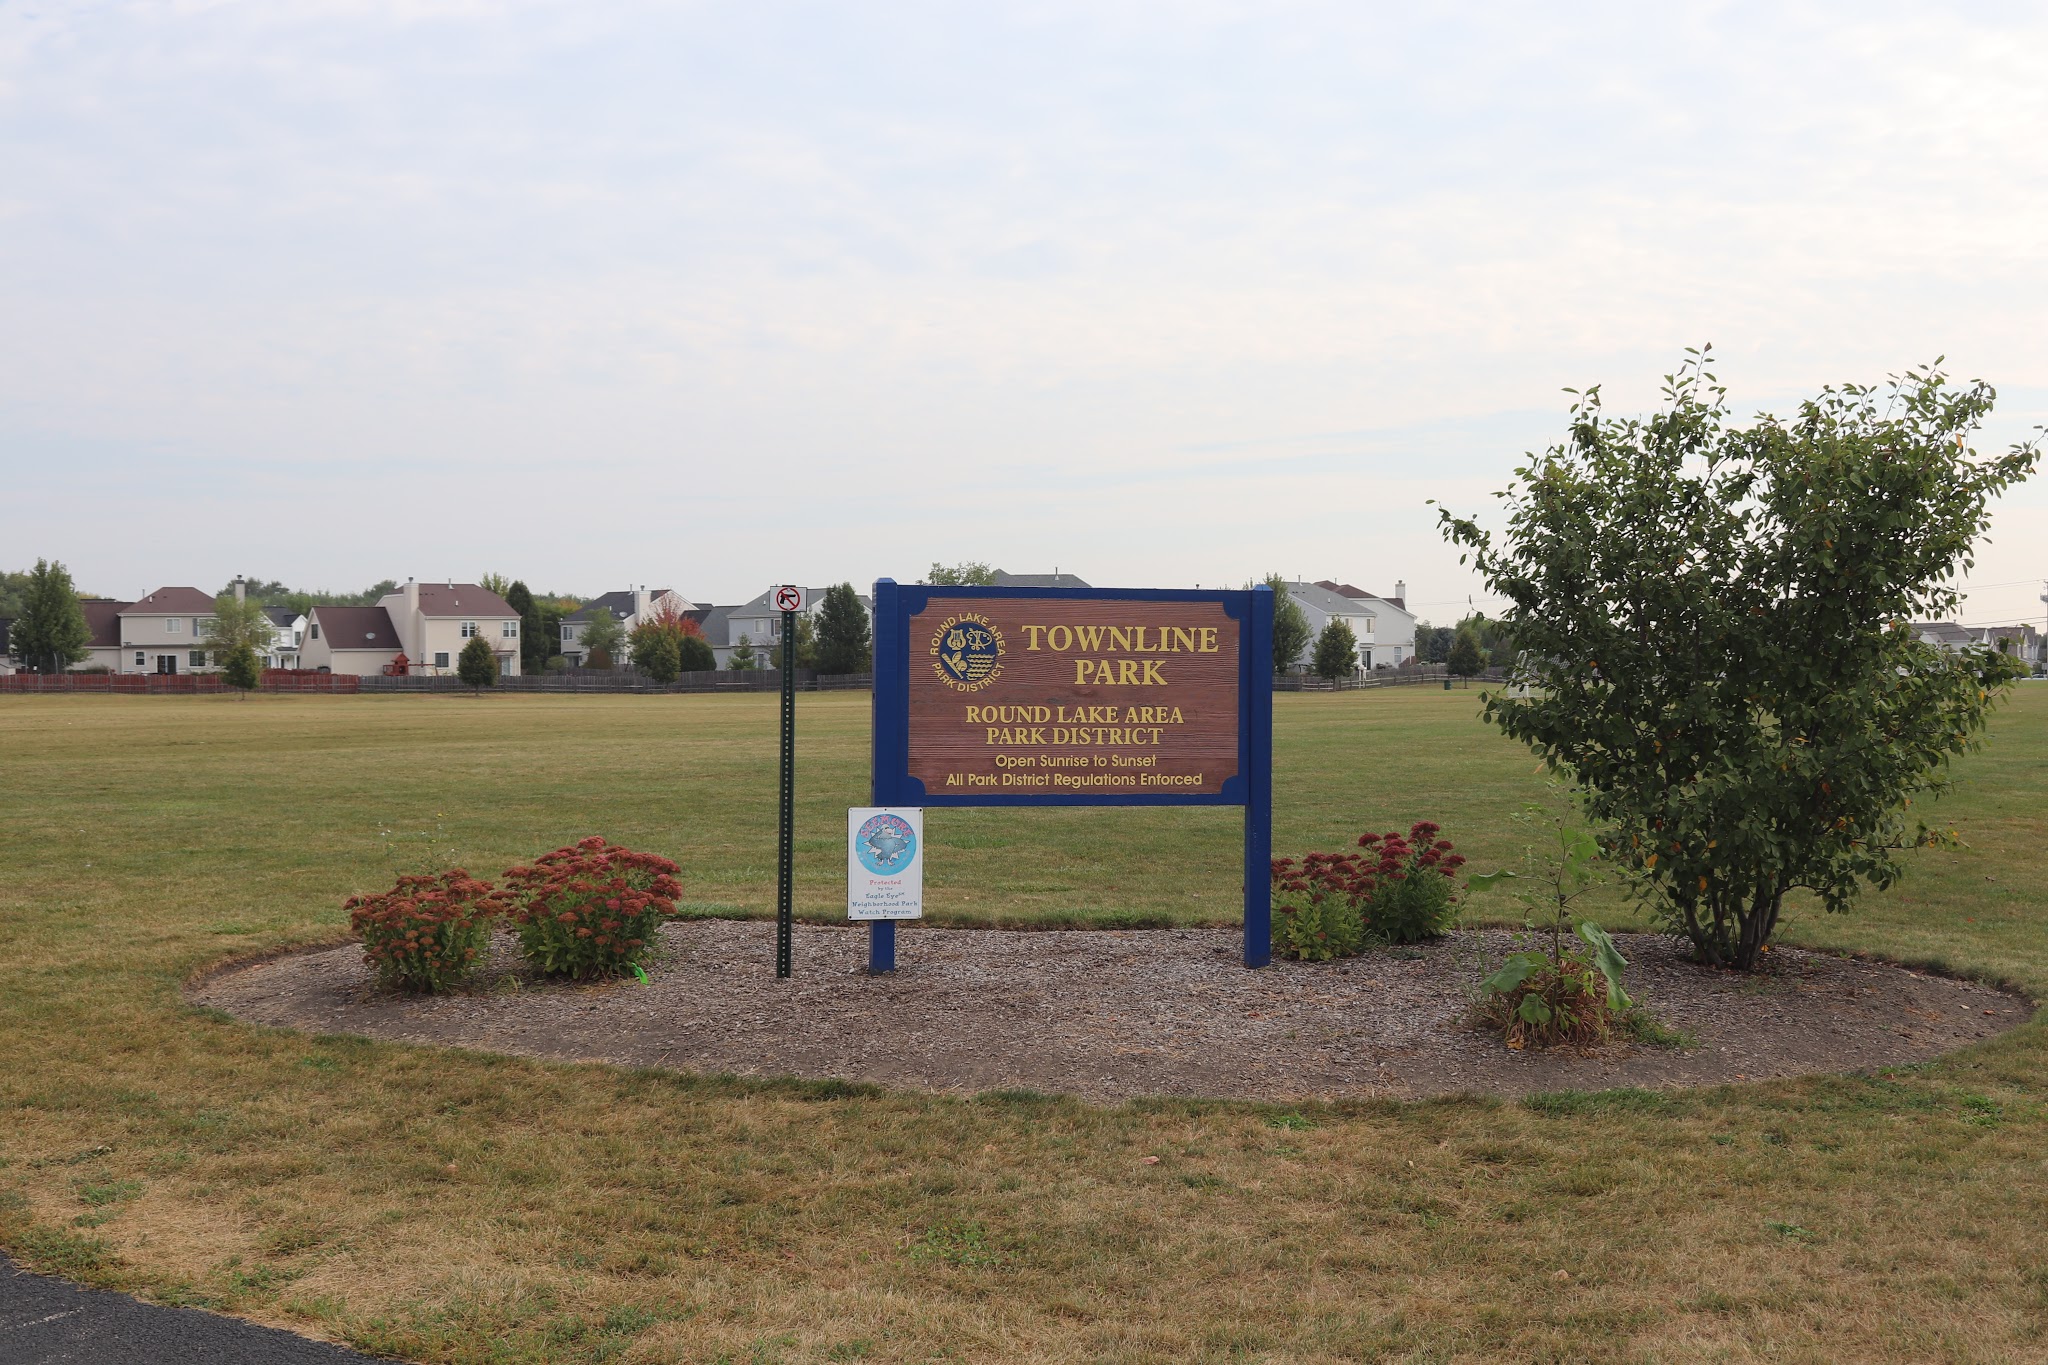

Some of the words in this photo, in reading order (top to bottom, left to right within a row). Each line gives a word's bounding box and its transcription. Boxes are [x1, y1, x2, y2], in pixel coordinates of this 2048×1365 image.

[930, 616, 956, 655] ROUND
[959, 612, 989, 627] LAKE
[988, 625, 1006, 656] AREA
[1021, 625, 1219, 652] TOWNLINE
[931, 662, 957, 688] PARK
[957, 662, 1005, 692] DISTRICT
[1074, 659, 1168, 685] PARK
[965, 705, 1051, 724] ROUND
[1057, 706, 1119, 724] LAKE
[1124, 706, 1184, 724] AREA
[986, 727, 1047, 745] PARK
[1052, 727, 1164, 746] DISTRICT
[995, 754, 1036, 769] Open
[1040, 754, 1089, 767] Sunrise
[1093, 755, 1107, 767] to
[1111, 754, 1157, 767] Sunset
[946, 773, 963, 786] All
[968, 773, 998, 786] Park
[1002, 773, 1050, 786] District
[1054, 773, 1136, 788] Regulations
[1140, 773, 1203, 786] Enforced
[860, 815, 915, 839] SEEMORE
